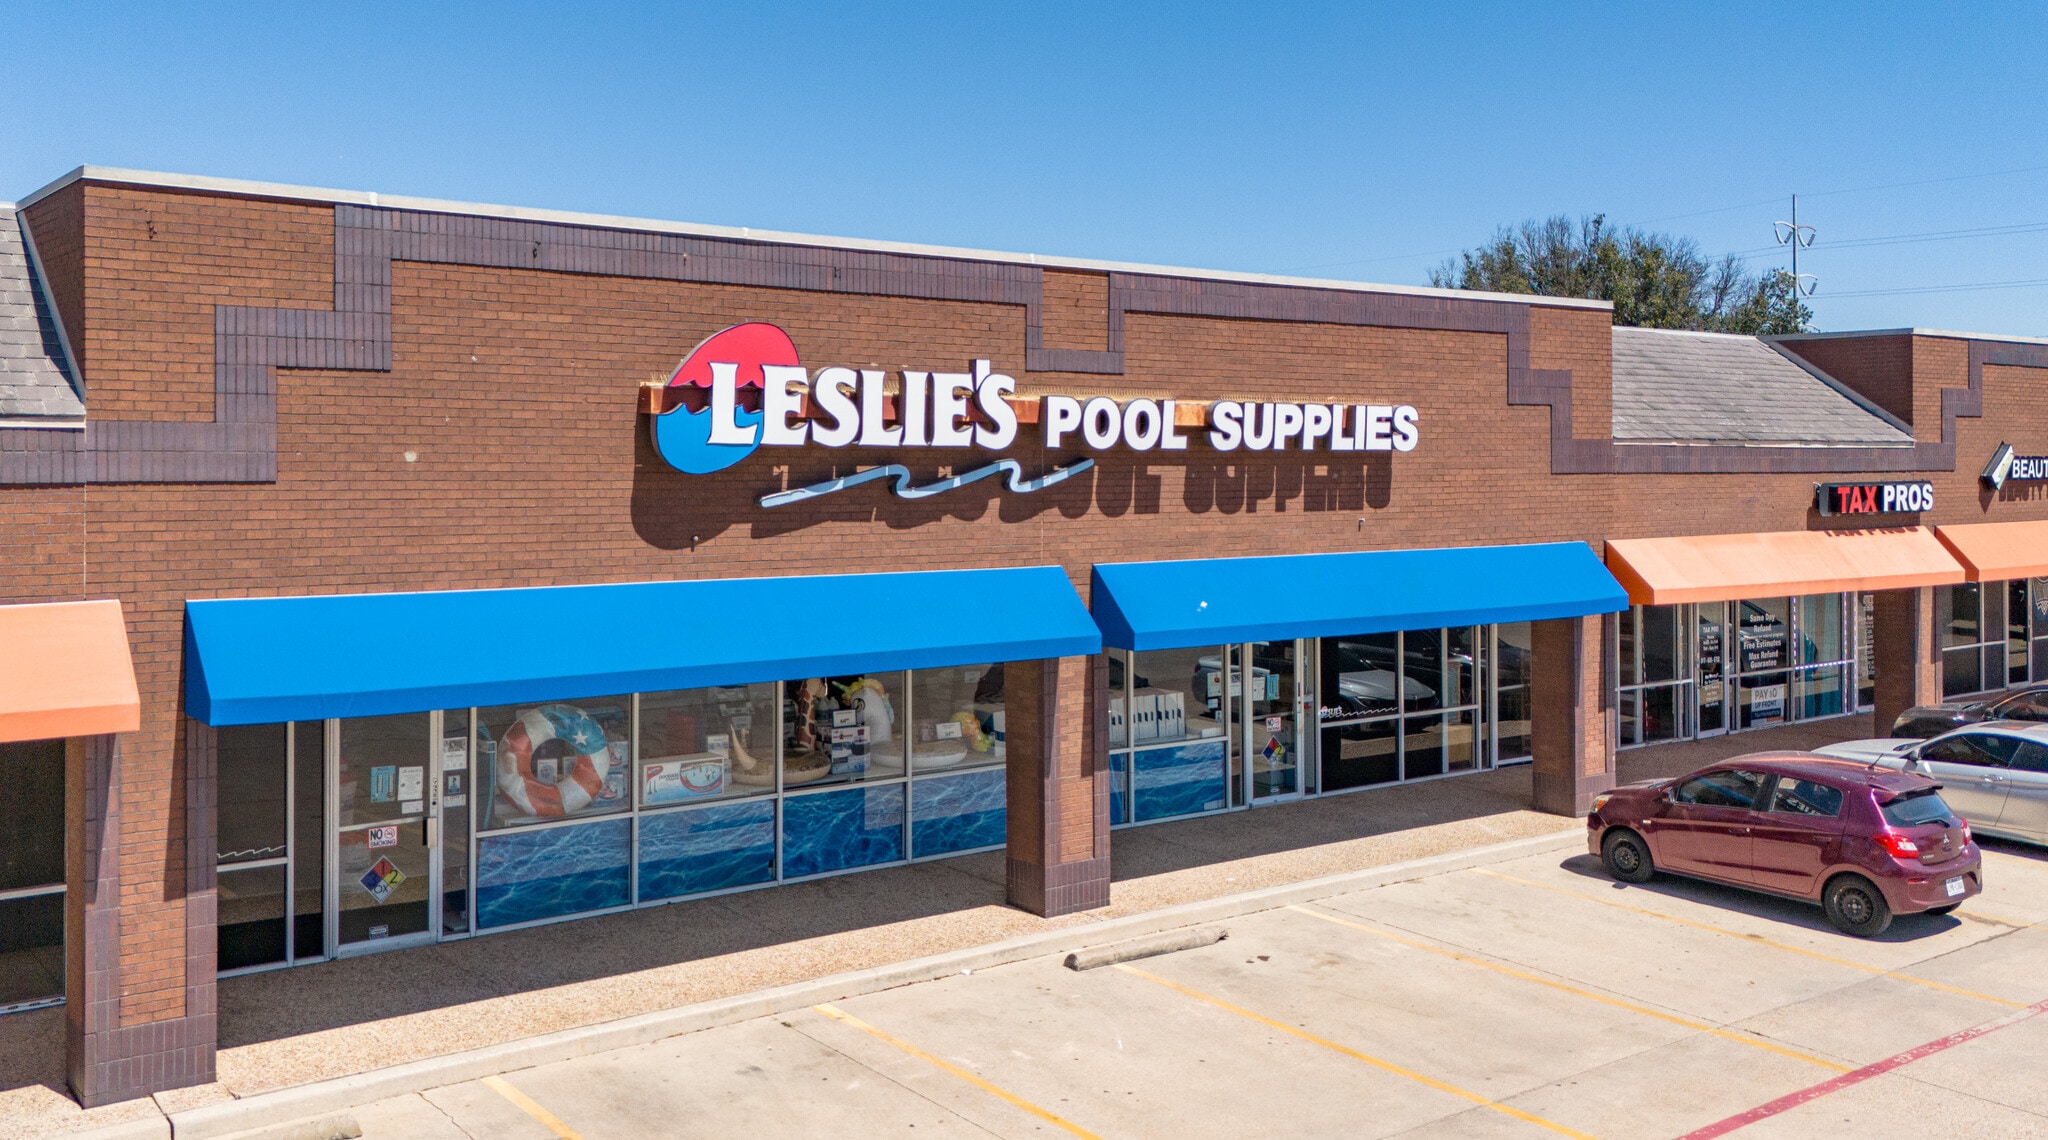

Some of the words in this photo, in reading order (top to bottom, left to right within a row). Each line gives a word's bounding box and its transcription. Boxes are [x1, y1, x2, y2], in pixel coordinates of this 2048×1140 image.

[706, 359, 1018, 450] LESLIE'S
[1046, 396, 1187, 450] POOL
[1209, 400, 1419, 452] SUPPLIES
[1837, 486, 1878, 513] TAX
[1883, 484, 1933, 511] PROS
[1743, 641, 1755, 649] Free
[1756, 639, 1781, 648] Estimates
[1761, 650, 1779, 659] Refund
[1750, 660, 1777, 669] Guarantee
[1755, 689, 1768, 700] PAY
[370, 829, 383, 841] NO
[371, 838, 396, 846] SMOKING
[389, 869, 398, 883] 2
